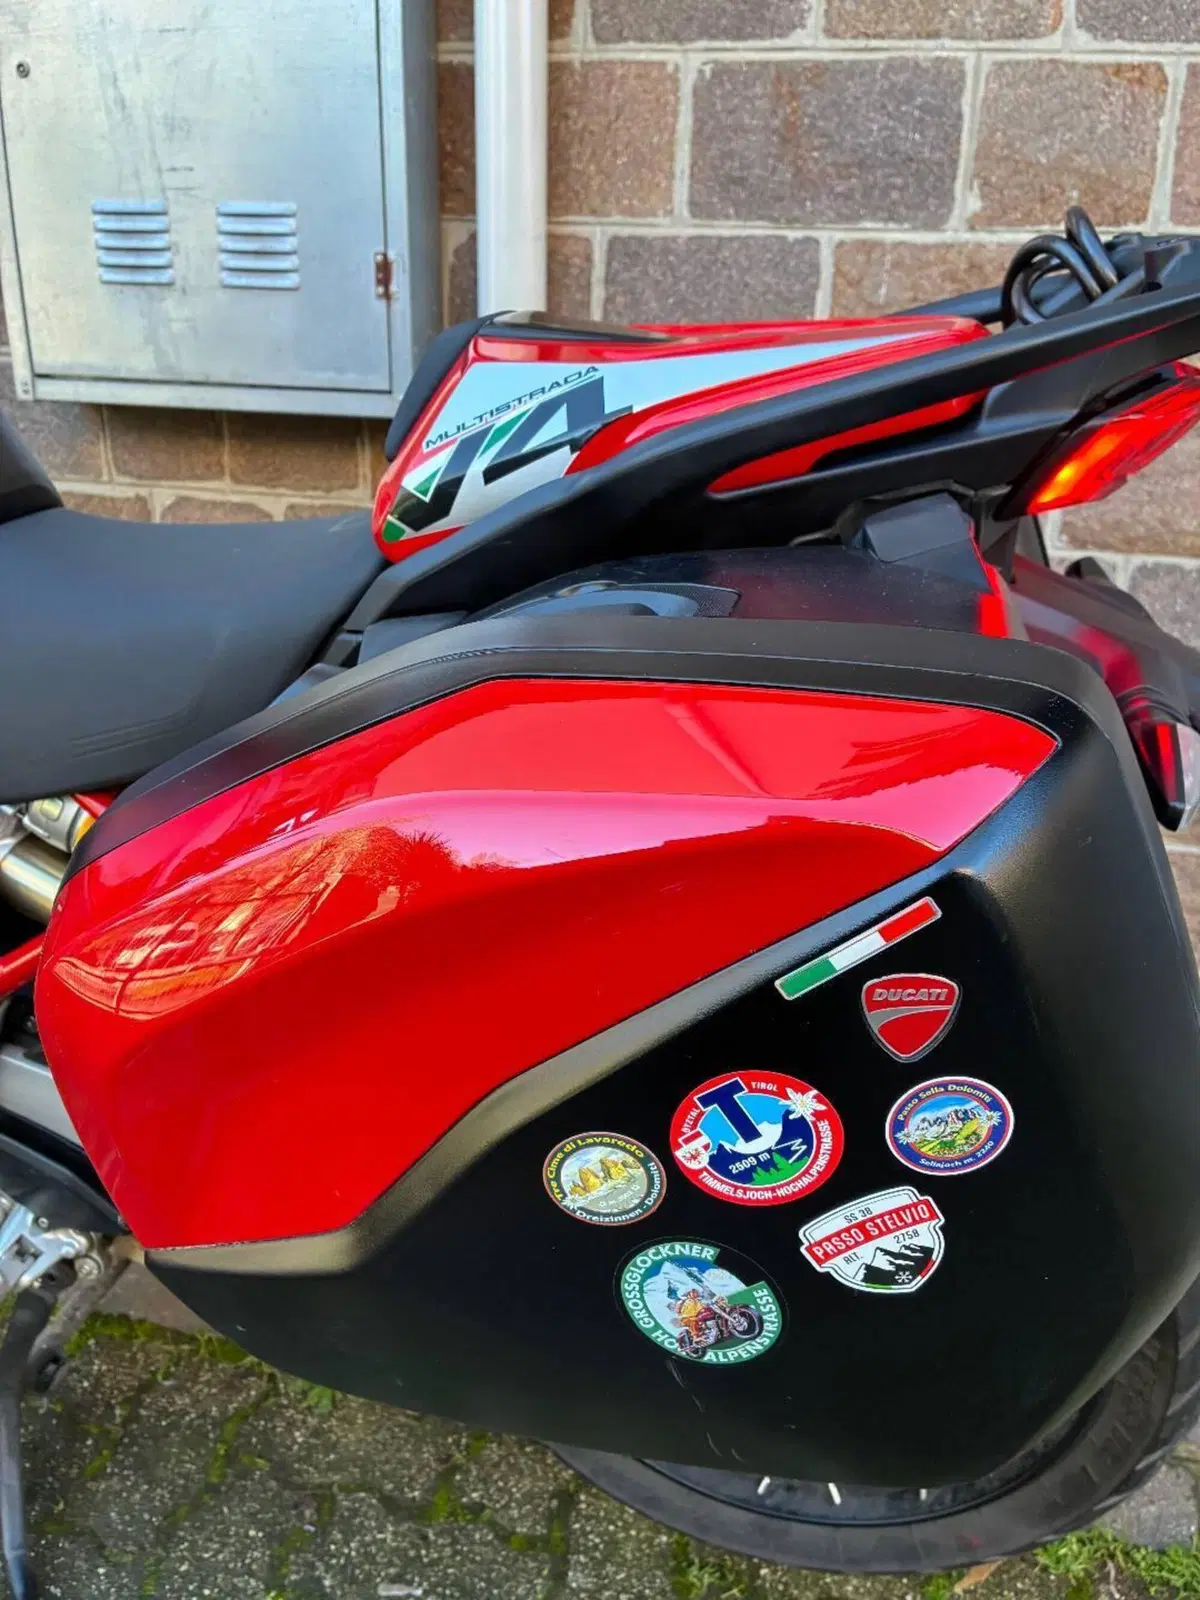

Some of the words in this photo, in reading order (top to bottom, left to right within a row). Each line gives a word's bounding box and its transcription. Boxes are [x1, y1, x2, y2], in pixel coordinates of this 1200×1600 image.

[425, 366, 599, 450] MULTISTRADA
[872, 988, 949, 1001] DUCATI
[751, 1081, 778, 1092] TIROL
[897, 1098, 918, 1120] Passo
[919, 1086, 944, 1100] Sella
[948, 1084, 993, 1104] Dolomiti
[563, 1142, 577, 1153] di
[578, 1136, 645, 1158] Lavaredo
[698, 1119, 833, 1200] TIMMELSJOCH-HOCHALPENSTRASSE
[547, 1152, 565, 1179] Cime
[728, 1155, 758, 1175] 2509
[759, 1152, 771, 1163] m
[919, 1158, 963, 1169] Sellajoch
[550, 1181, 564, 1200] Tre
[575, 1208, 643, 1223] Dreizinnen
[644, 1161, 661, 1206] Dolomiti
[844, 1213, 859, 1224] SS
[860, 1206, 874, 1217] 38
[812, 1227, 865, 1260] PASSO
[865, 1203, 931, 1236] STELVIO
[842, 1251, 865, 1265] ALT.
[893, 1228, 921, 1245] 2758
[624, 1243, 716, 1329] GROSSGLOCKNER
[703, 1287, 779, 1362] ALPENSTRASSE
